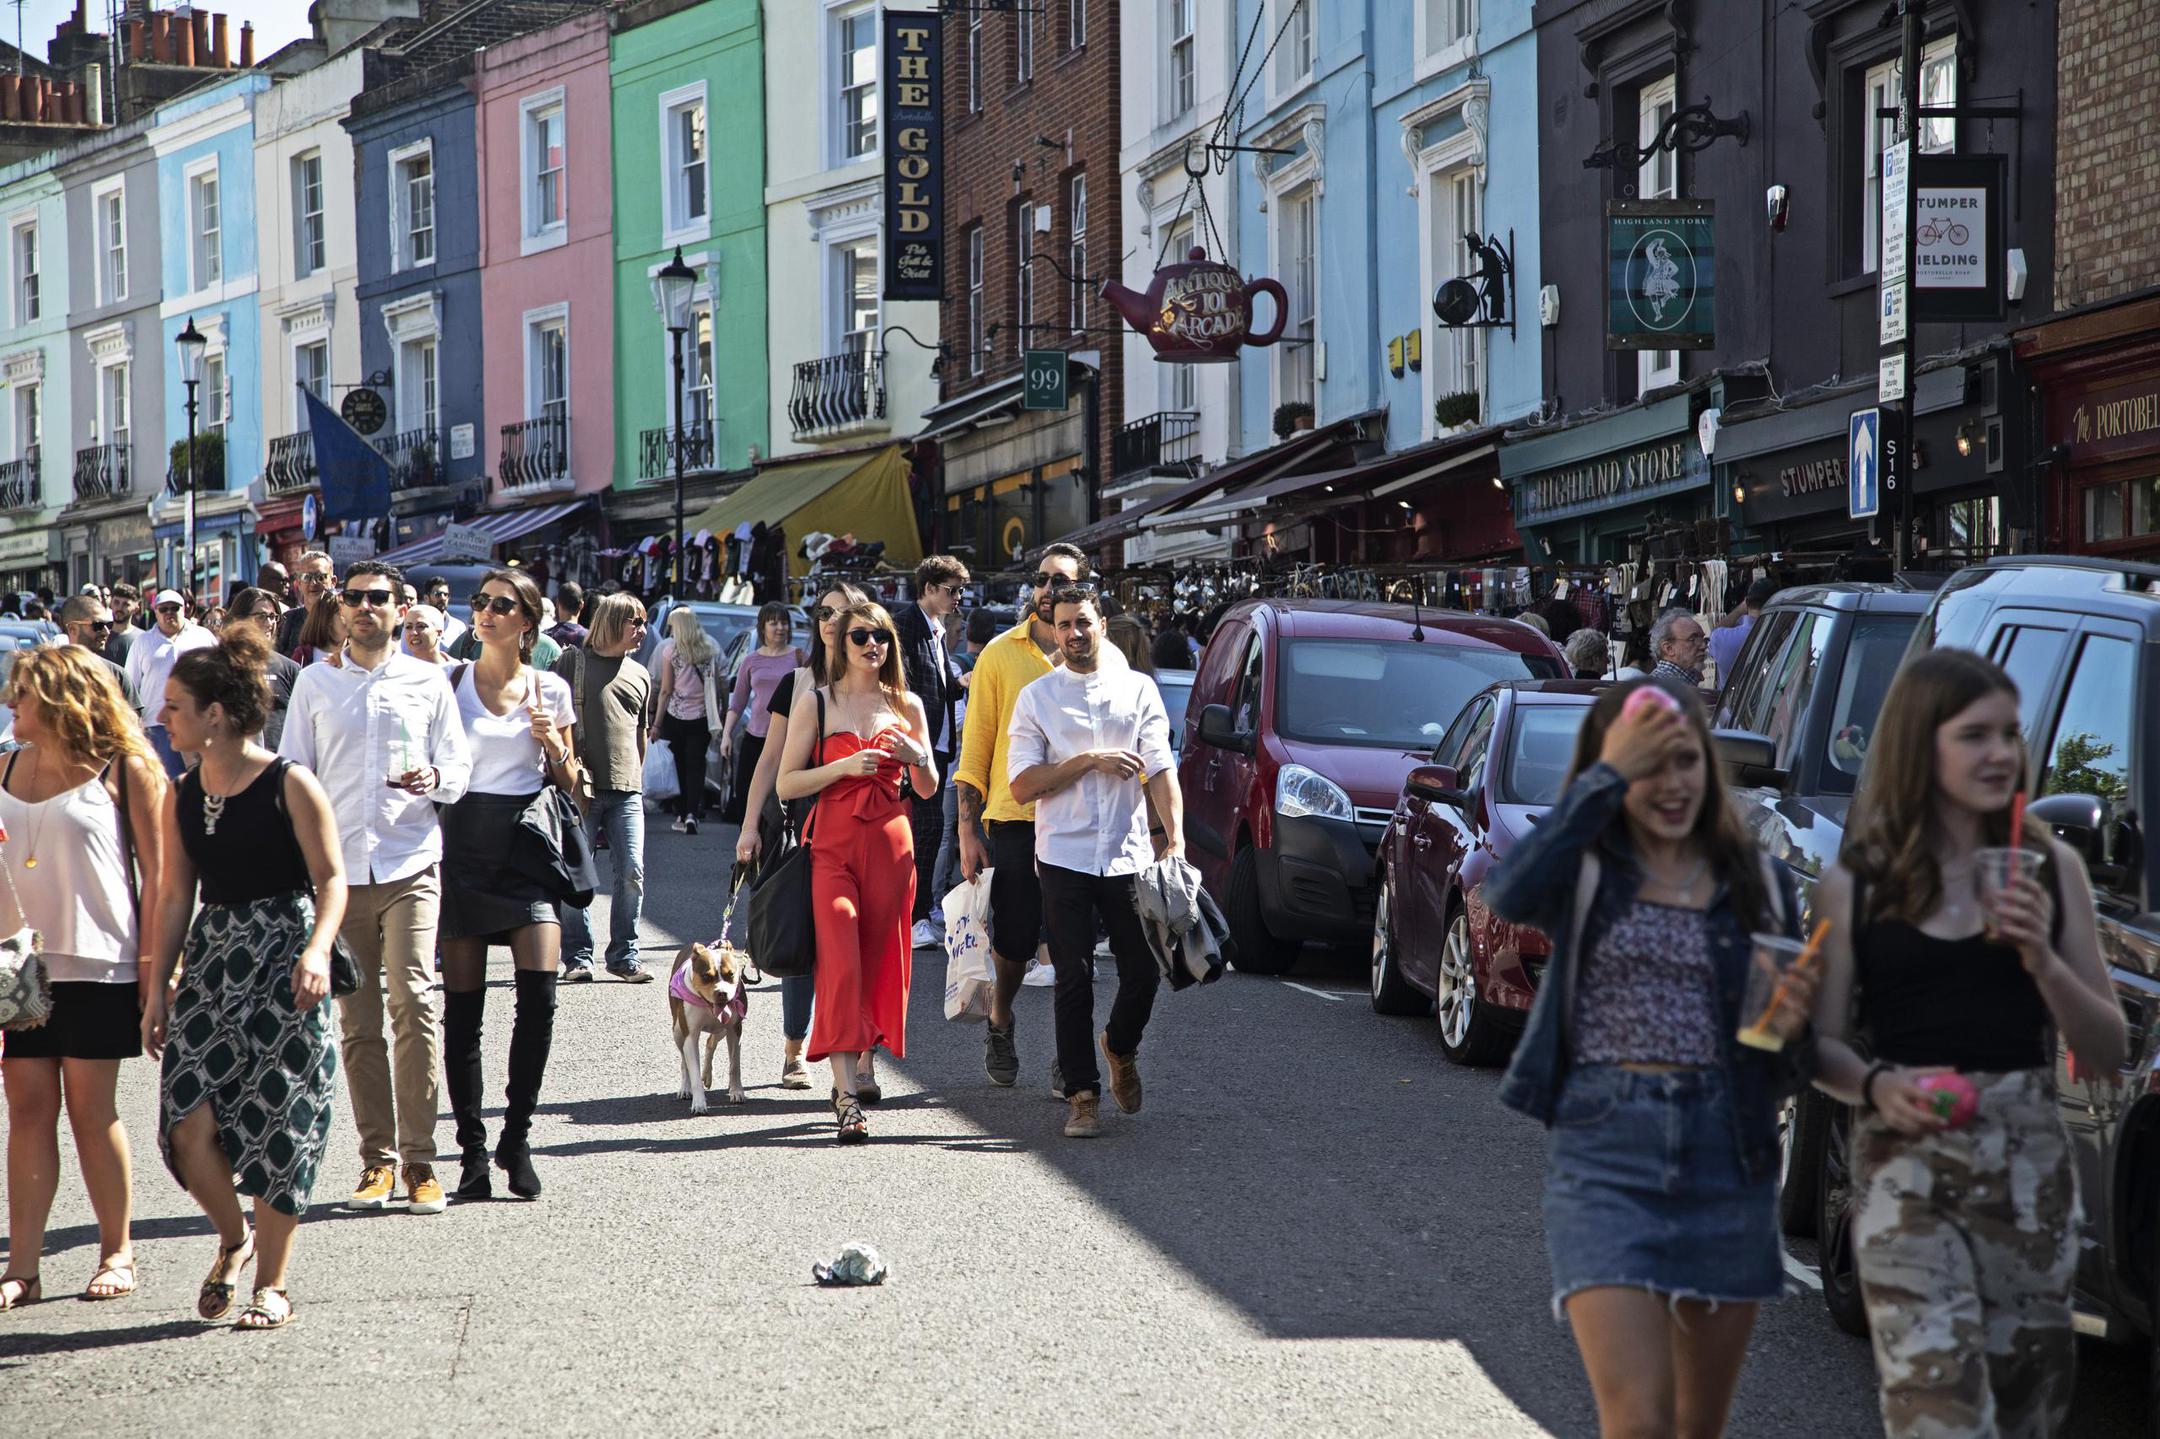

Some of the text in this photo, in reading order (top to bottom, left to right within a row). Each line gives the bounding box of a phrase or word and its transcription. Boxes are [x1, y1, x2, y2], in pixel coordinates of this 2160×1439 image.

[897, 28, 929, 106] THE
[897, 127, 930, 232] GOLD
[1917, 198, 1978, 209] TUMPER
[905, 244, 927, 255] Pub
[1917, 255, 1978, 266] IELDING
[1202, 291, 1229, 313] 101
[1031, 368, 1060, 390] 99
[2072, 404, 2092, 444] The
[1536, 443, 1681, 510] HIGHLAND STORE
[1780, 458, 1844, 497] STUMPER
